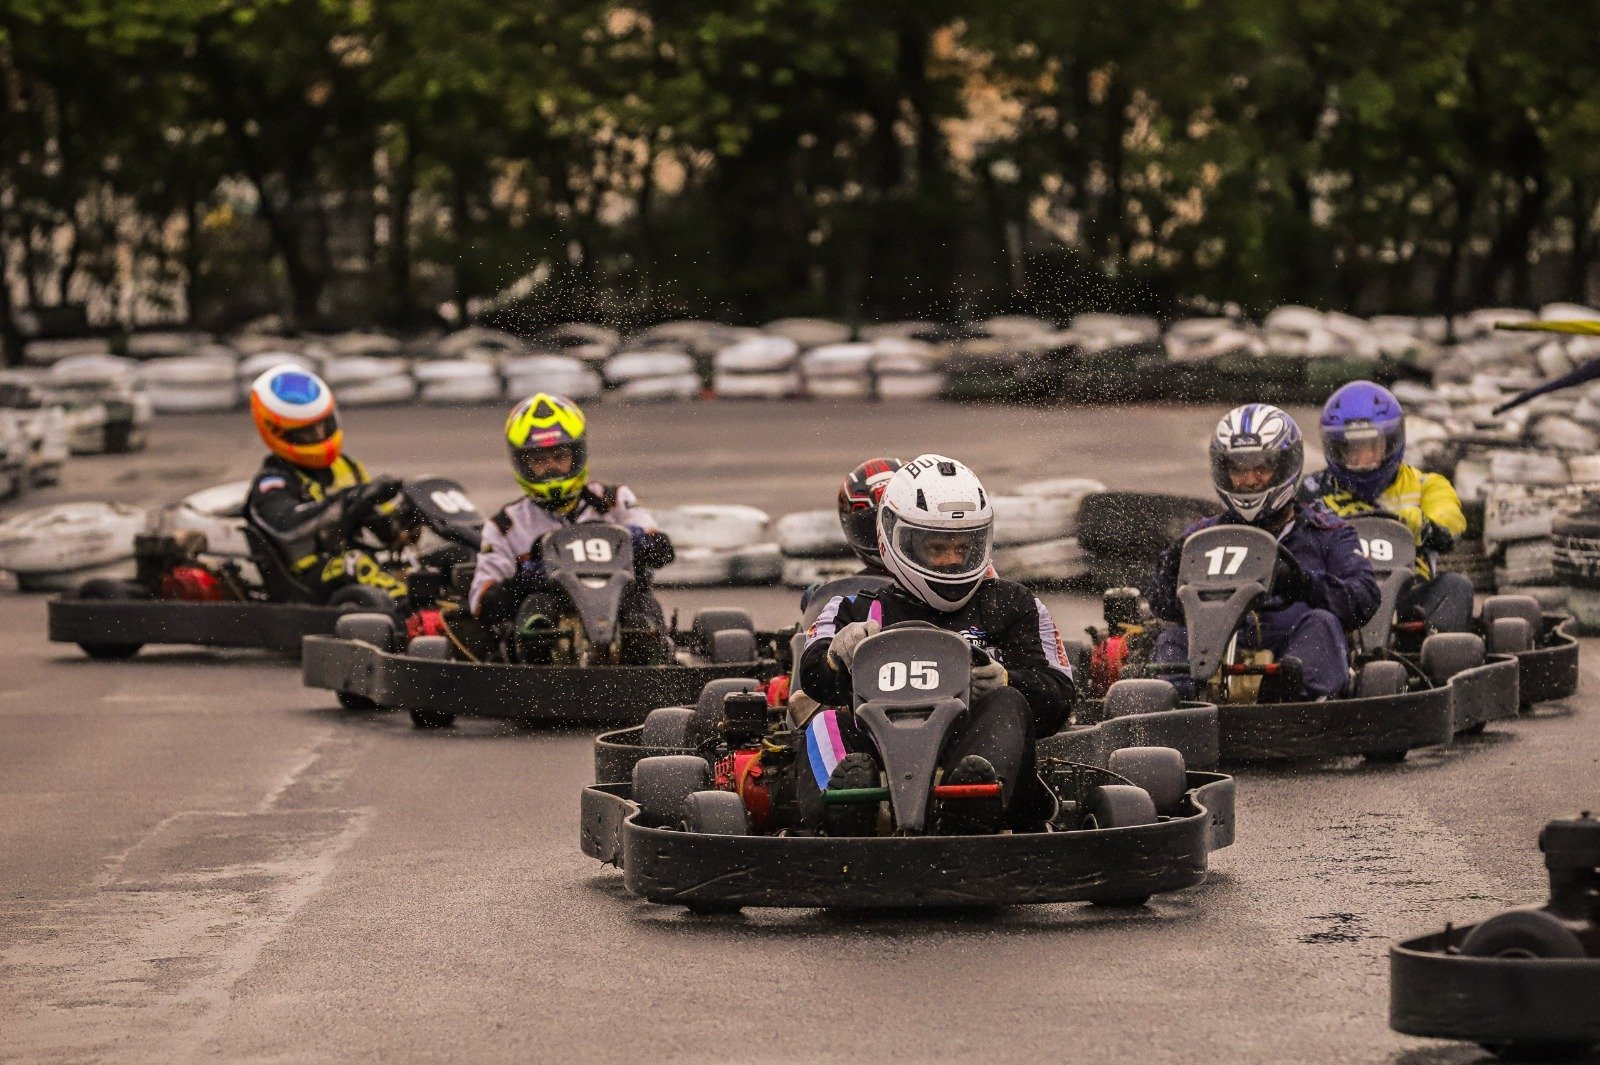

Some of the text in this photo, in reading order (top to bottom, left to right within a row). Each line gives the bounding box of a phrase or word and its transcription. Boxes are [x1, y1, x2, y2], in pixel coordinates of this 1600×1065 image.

[565, 538, 612, 562] 19
[1204, 546, 1249, 575] 17
[878, 660, 940, 692] 05
